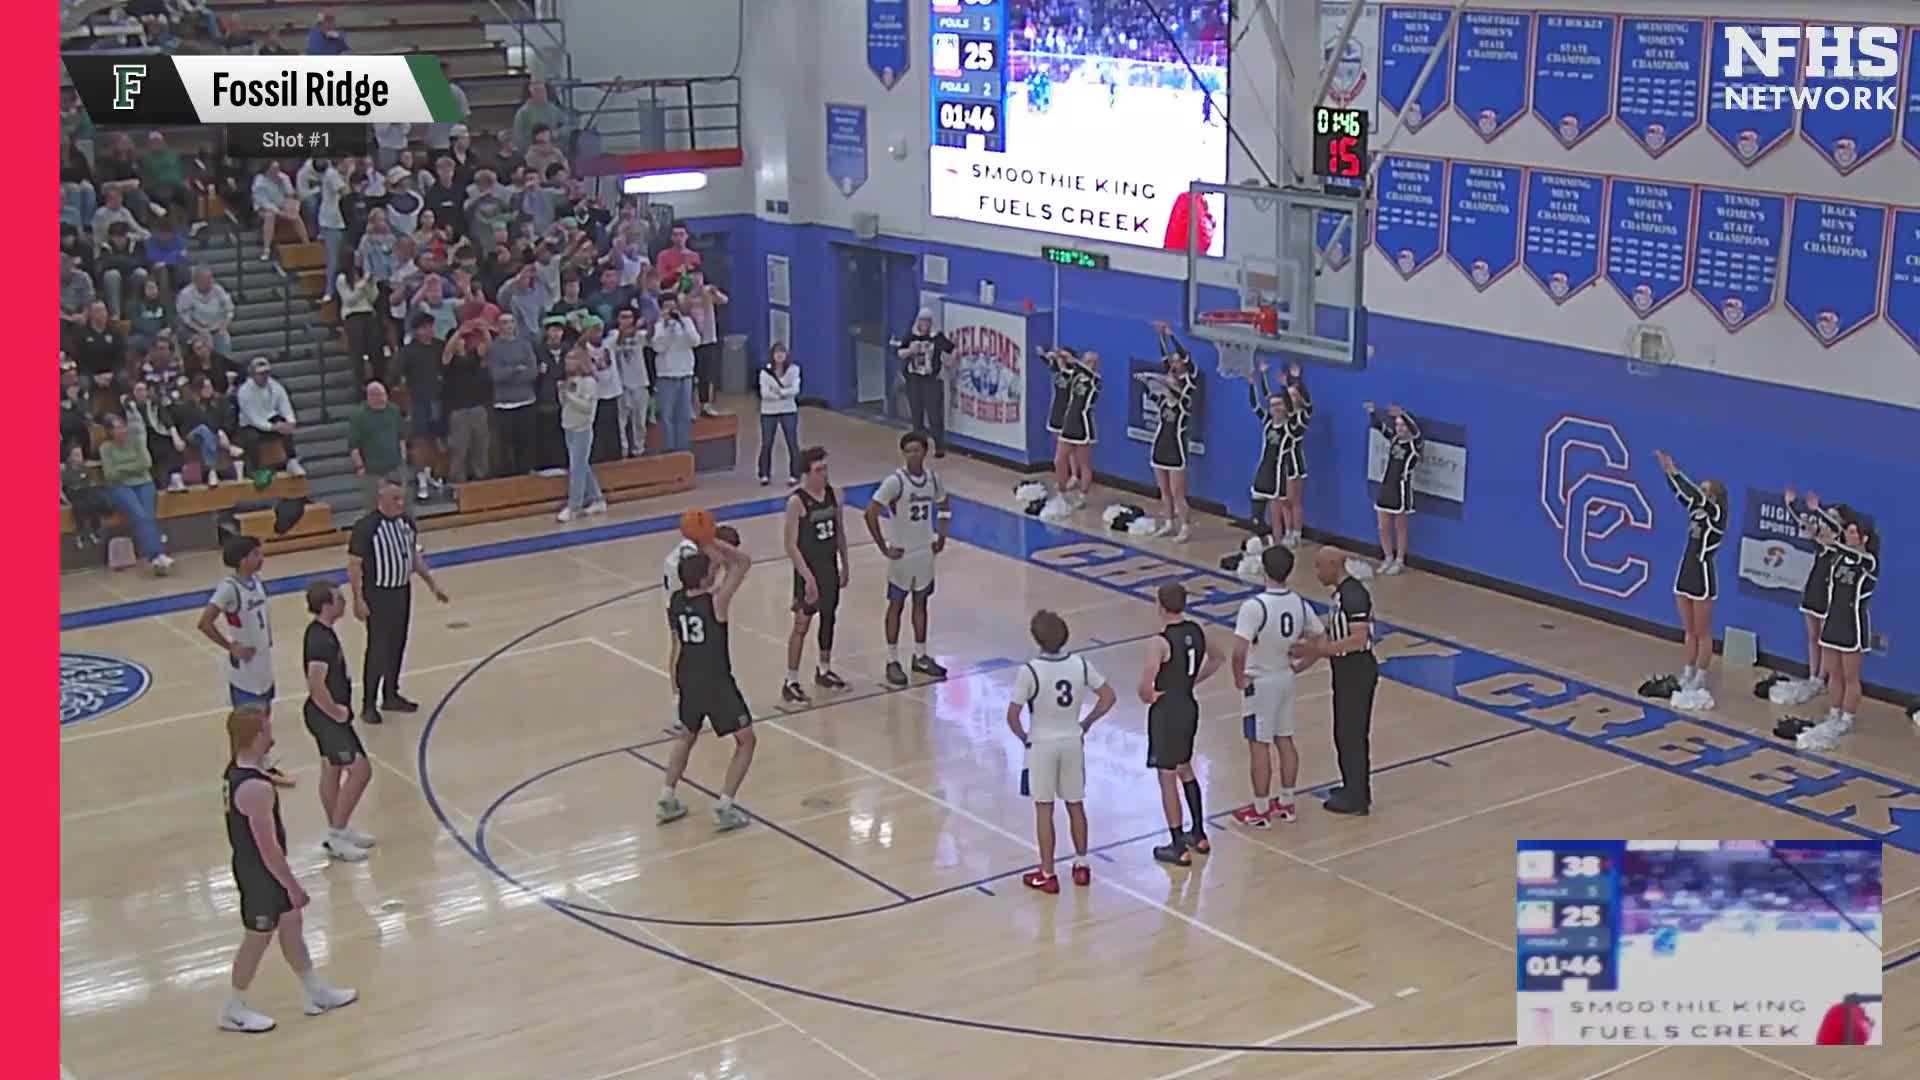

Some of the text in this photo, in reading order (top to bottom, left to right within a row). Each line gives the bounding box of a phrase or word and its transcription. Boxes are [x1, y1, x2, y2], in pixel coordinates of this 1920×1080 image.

[982, 17, 991, 31] 5
[1638, 34, 1685, 47] WOMEN'S
[964, 41, 994, 70] 25
[1466, 48, 1519, 61] CHAMPIONS
[1560, 43, 1588, 54] STATE
[1645, 49, 1676, 60] STATE
[1546, 53, 1602, 65] CHAMPIONS
[1631, 59, 1690, 71] CHAMPIONS
[983, 83, 992, 96] 2
[940, 103, 995, 132] 01:46
[1317, 109, 1360, 136] 01:46
[1328, 137, 1360, 177] 15
[972, 163, 1157, 200] SMOOTHIE KING
[1459, 200, 1510, 214] CHAMPIONS
[1549, 201, 1578, 213] STATE
[1627, 197, 1673, 211] WOMEN'S
[1724, 195, 1761, 207] TENNIS
[978, 195, 1150, 233] FUELS CREEK
[1537, 209, 1591, 224] CHAMPIONS
[1633, 211, 1664, 223] STATE
[1716, 207, 1766, 222] WOMEN'S
[1820, 204, 1858, 218] TRACK
[1620, 220, 1678, 236] CHAMPIONS
[1723, 222, 1756, 235] STATE
[1820, 218, 1856, 232] MEN'S
[1708, 231, 1770, 248] CHAMPIONS
[1819, 232, 1854, 246] STATE
[1803, 242, 1868, 259] CHAMPIONS
[949, 325, 1021, 376] WELCOME
[910, 504, 929, 522] 23
[1759, 519, 1796, 537] SPORTS
[678, 614, 705, 643] 13
[1280, 611, 1294, 638] 0
[1185, 647, 1196, 677] 1
[1055, 678, 1074, 707] 3
[1455, 672, 1920, 835] CREEK
